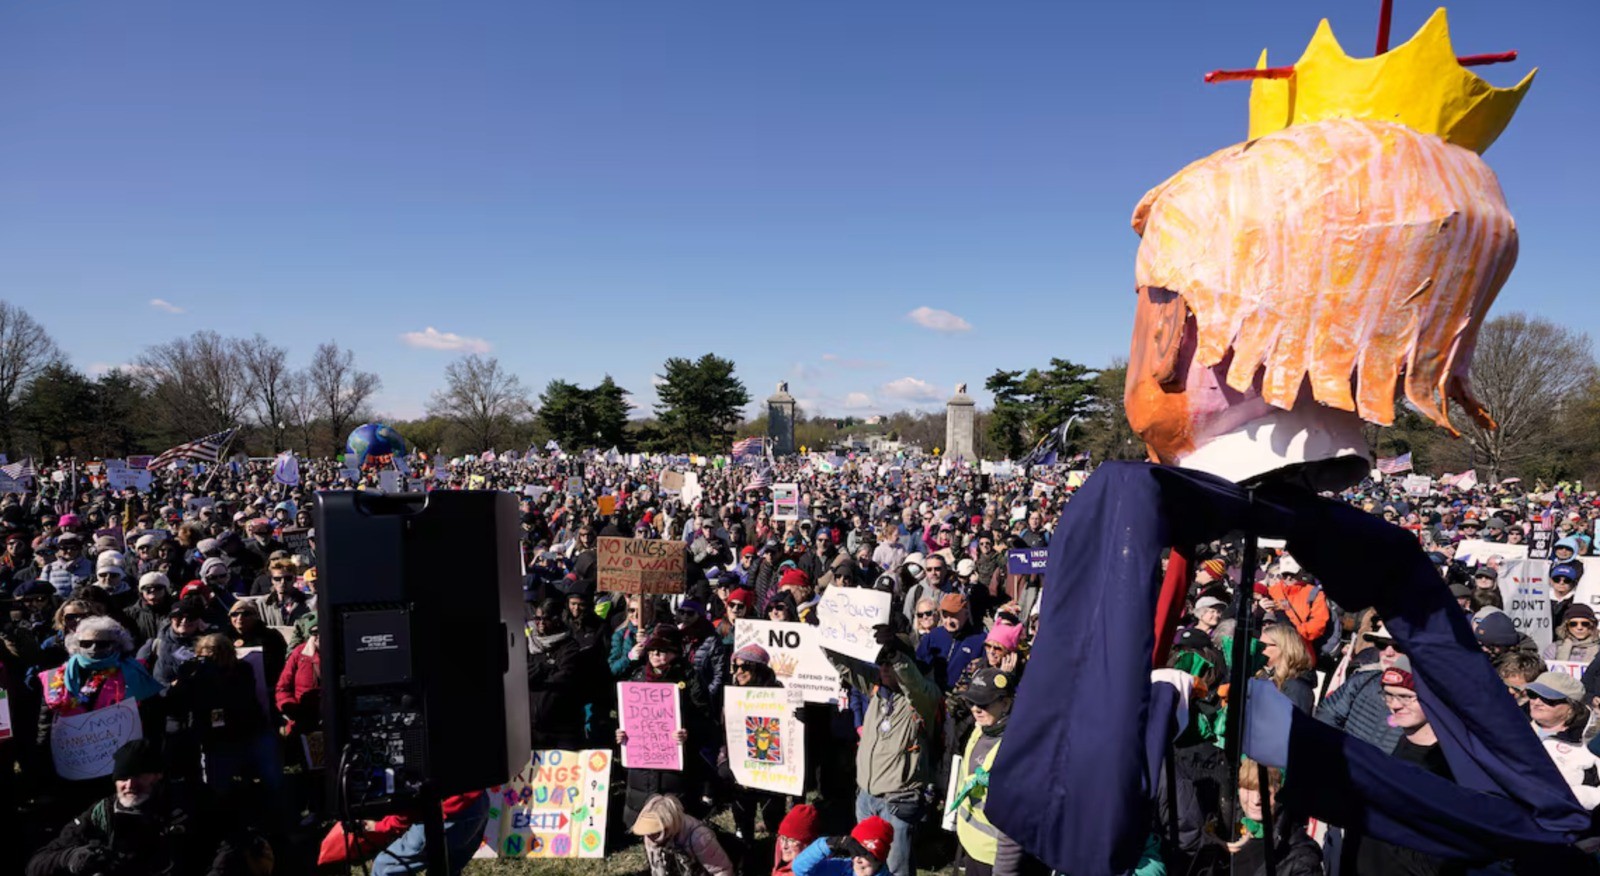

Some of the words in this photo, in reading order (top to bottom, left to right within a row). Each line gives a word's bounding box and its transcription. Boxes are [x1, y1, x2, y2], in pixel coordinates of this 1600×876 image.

[599, 538, 621, 554] NO
[607, 556, 633, 568] NO
[638, 557, 682, 571] WAR
[599, 577, 652, 593] EPSTEIN
[1512, 600, 1545, 611] DON'T
[1536, 617, 1550, 628] TO
[361, 634, 394, 643] QSC
[768, 629, 801, 649] NO
[797, 673, 823, 681] DEFEND
[824, 674, 837, 682] THE
[628, 686, 673, 704] STEP
[788, 683, 835, 692] CONSTITUTION
[627, 705, 674, 720] DOWN
[88, 711, 128, 732] MOM
[640, 720, 671, 732] PETE
[641, 732, 670, 744] PAM
[642, 742, 675, 752] KASH
[531, 750, 563, 767] NO
[643, 752, 676, 762] BOBBY
[504, 785, 580, 807] TRUMP
[511, 812, 559, 829] EXIT
[506, 834, 570, 854] NOW
